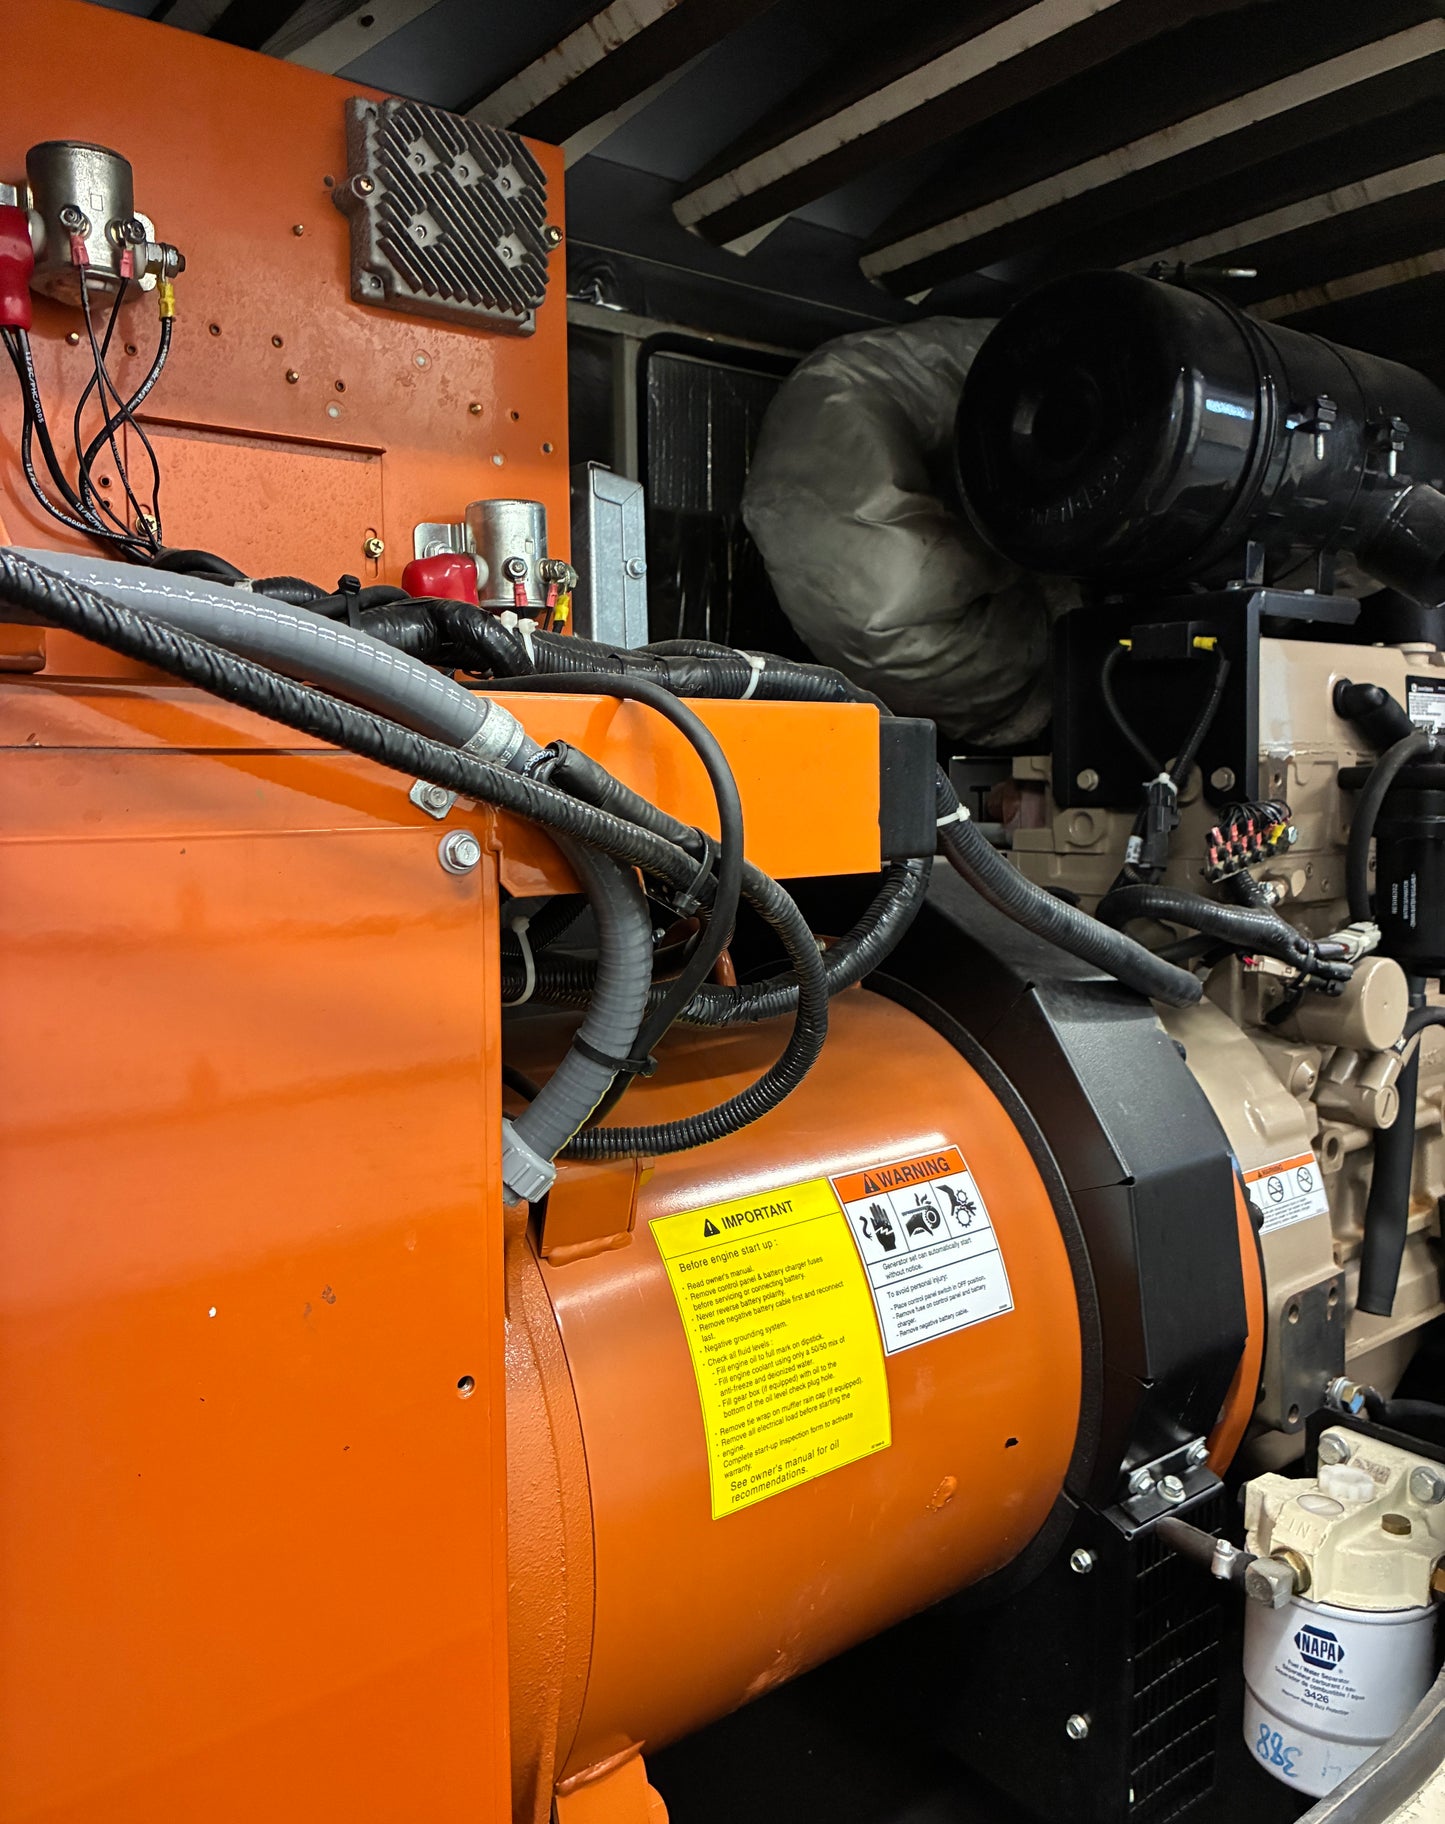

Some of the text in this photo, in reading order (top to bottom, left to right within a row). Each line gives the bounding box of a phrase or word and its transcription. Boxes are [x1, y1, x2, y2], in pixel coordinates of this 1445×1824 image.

[876, 1157, 950, 1188] WARNING
[720, 1200, 792, 1229] IMPORTANT
[678, 1240, 772, 1272] Before engine start up
[882, 1257, 907, 1270] Generator
[928, 1241, 959, 1255] automatically
[686, 1279, 704, 1290] Read
[705, 1272, 729, 1284] owner's
[689, 1288, 716, 1300] Remove
[717, 1280, 738, 1292] control
[739, 1275, 756, 1287] panel
[762, 1268, 783, 1278] battery
[784, 1261, 806, 1272] charger
[807, 1256, 822, 1265] fuses
[885, 1268, 905, 1279] without
[895, 1286, 909, 1296] avoid
[910, 1278, 932, 1292] personal
[692, 1300, 713, 1310] before
[714, 1291, 742, 1304] servicing
[750, 1279, 783, 1293] connecting
[698, 1280, 843, 1331] Remove negative battery cable first and reconnect
[895, 1308, 914, 1319] Remove
[932, 1296, 948, 1306] control
[948, 1291, 961, 1300] panel
[970, 1284, 985, 1292] battery
[907, 1295, 923, 1305] control
[924, 1290, 936, 1300] panel
[937, 1286, 951, 1295] switch
[957, 1280, 966, 1288] OFF
[695, 1310, 714, 1321] Never
[716, 1303, 739, 1315] reverse
[739, 1296, 761, 1307] battery
[899, 1326, 918, 1336] Remove
[919, 1319, 938, 1329] negative
[938, 1313, 954, 1322] battery
[704, 1339, 732, 1352] Negative
[733, 1328, 764, 1345] grounding
[707, 1354, 727, 1366] Check
[737, 1346, 751, 1356] fluid
[751, 1340, 769, 1351] levels
[716, 1365, 726, 1374] Fill
[727, 1359, 748, 1371] engine
[765, 1349, 774, 1357] full
[776, 1344, 791, 1354] mark
[718, 1376, 728, 1385] Fill
[729, 1370, 750, 1381] engine
[751, 1360, 773, 1374] coolant
[774, 1355, 791, 1365] using
[792, 1350, 804, 1360] only
[810, 1342, 827, 1353] 50/50
[720, 1380, 752, 1396] anti-freeze
[754, 1374, 766, 1384] and
[767, 1364, 795, 1379] deionized
[722, 1398, 731, 1406] Fill
[733, 1393, 746, 1404] gear
[748, 1389, 760, 1397] box
[768, 1374, 798, 1390] equipped)
[799, 1370, 811, 1378] with
[719, 1421, 745, 1435] Remove
[756, 1412, 770, 1421] wrap
[781, 1400, 801, 1412] muffler
[802, 1395, 814, 1404] rain
[815, 1391, 825, 1399] cap
[723, 1405, 745, 1418] bottom
[746, 1401, 752, 1409] of
[773, 1388, 787, 1398] level
[788, 1382, 806, 1393] check
[807, 1378, 819, 1388] plug
[721, 1432, 746, 1446] Remove
[757, 1416, 783, 1432] electrical
[785, 1411, 798, 1421] load
[799, 1405, 817, 1416] before
[818, 1396, 840, 1409] starting
[723, 1451, 752, 1467] Complete
[754, 1442, 778, 1455] start-up
[779, 1429, 809, 1445] inspection
[810, 1424, 823, 1433] form
[831, 1412, 852, 1425] activate
[730, 1439, 839, 1491] See owner's manual for oil
[731, 1466, 807, 1502] recommendations.
[1288, 1518, 1310, 1538] IN
[1302, 1633, 1335, 1662] NAPA
[1303, 1666, 1320, 1677] Water
[1321, 1672, 1350, 1684] Separator
[1304, 1689, 1329, 1704] 3426
